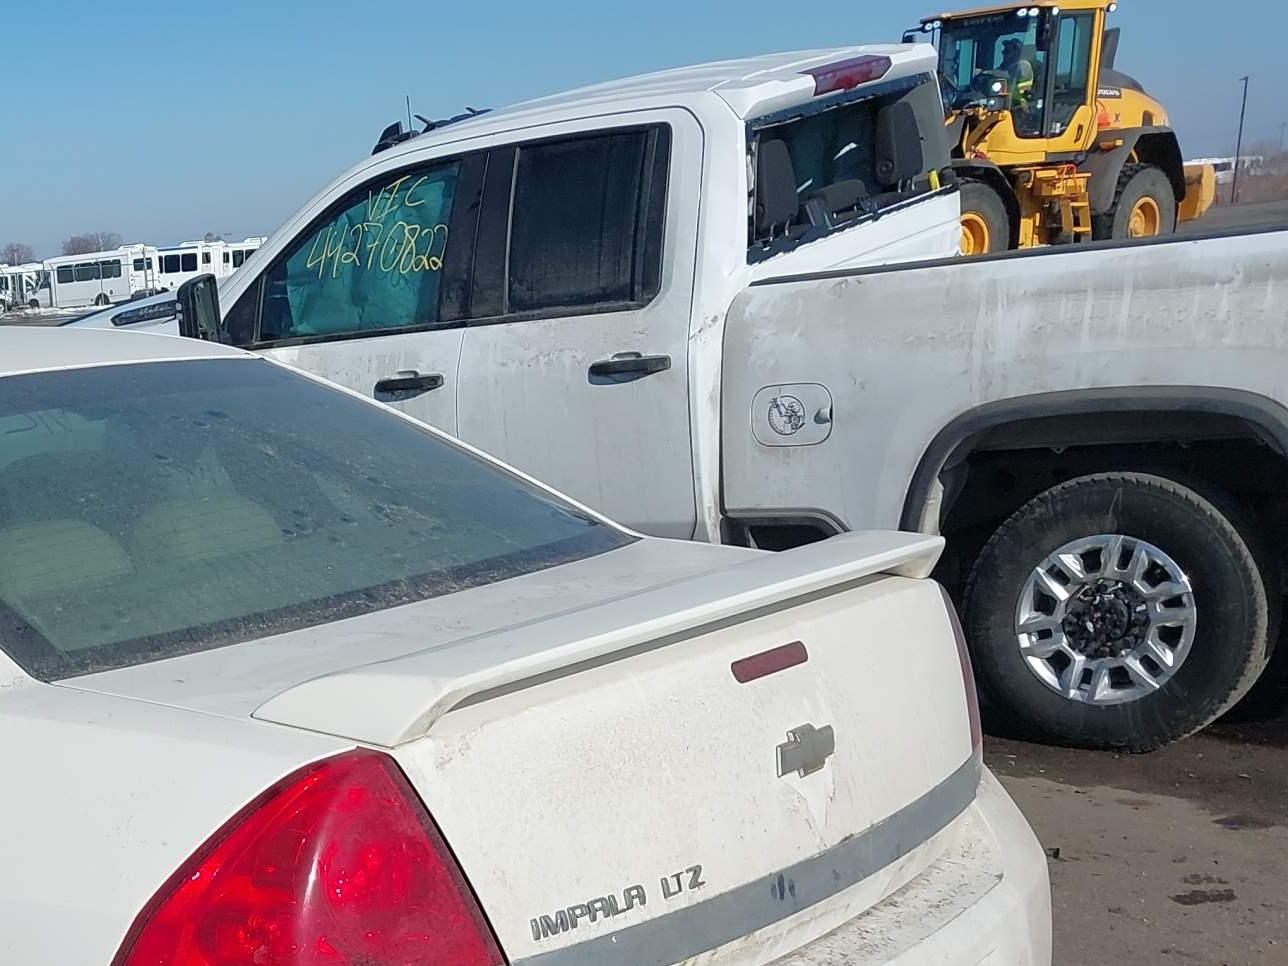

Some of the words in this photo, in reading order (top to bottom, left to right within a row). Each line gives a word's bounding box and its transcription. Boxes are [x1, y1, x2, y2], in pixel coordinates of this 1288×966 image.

[306, 221, 449, 279] 44270822
[529, 884, 647, 941] IMPALA
[660, 864, 706, 900] LTZ
